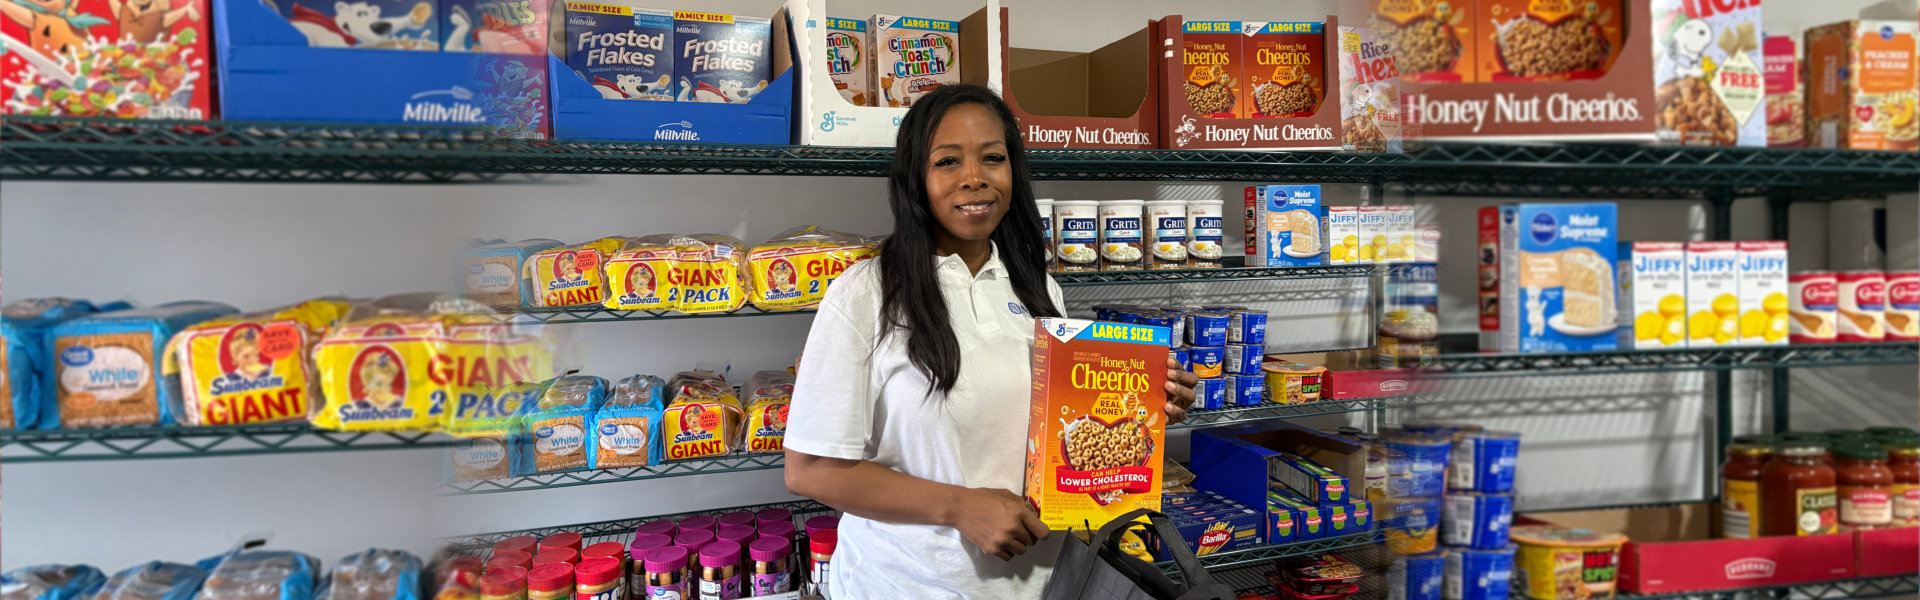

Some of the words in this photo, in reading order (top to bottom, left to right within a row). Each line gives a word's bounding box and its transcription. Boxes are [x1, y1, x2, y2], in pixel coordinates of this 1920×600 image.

[568, 3, 600, 11] FAMILY
[603, 5, 621, 13] SIZE
[675, 12, 704, 20] FAMILY
[570, 18, 597, 26] Millville
[838, 20, 857, 29] SIZE
[902, 19, 929, 29] LARGE
[932, 21, 950, 30] SIZE
[1187, 23, 1212, 31] LARGE
[1213, 23, 1230, 31] SIZE
[676, 26, 701, 34] Millville
[1269, 24, 1294, 32] LARGE
[1296, 24, 1311, 32] SIZE
[578, 30, 664, 51] Frosted
[891, 36, 943, 50] Cinnamon
[683, 37, 763, 58] Frosted
[1194, 43, 1211, 51] Honey
[1276, 43, 1294, 51] Honey
[1361, 42, 1389, 59] Rice
[587, 47, 656, 67] Flakes
[901, 47, 936, 62] Toast
[1257, 48, 1310, 65] Cheerios
[692, 54, 754, 73] Flakes
[896, 58, 945, 77] Crunch
[1874, 61, 1909, 69] CREAM
[1720, 72, 1759, 88] FREE
[403, 102, 482, 122] Millville
[1377, 113, 1399, 122] FREE
[1407, 93, 1488, 133] Honey
[1495, 93, 1540, 123] Nut
[1546, 92, 1639, 122] Cheerios
[655, 130, 698, 141] Millville
[1029, 125, 1072, 147] Honey
[1075, 127, 1099, 143] Nut
[1103, 128, 1149, 145] Cheerios
[1205, 125, 1250, 146] Honey
[1253, 124, 1279, 141] Nut
[1282, 124, 1332, 141] Cheerios
[1289, 197, 1316, 206] Supreme
[1164, 219, 1185, 228] GRITS
[1201, 218, 1222, 228] GRITS
[1331, 214, 1356, 223] JIFFY
[1360, 214, 1385, 223] JIFFY
[1389, 214, 1412, 222] JIFFY
[1569, 213, 1599, 226] Moist
[1068, 220, 1094, 230] GRITS
[1111, 219, 1138, 229] GRITS
[1560, 226, 1608, 241] Supreme
[1636, 256, 1681, 272] JIFFY
[1689, 256, 1735, 272] JIFFY
[1741, 255, 1785, 272] JIFFY
[482, 274, 509, 283] White
[549, 279, 588, 290] Sunbeam
[809, 280, 819, 293] 2
[547, 286, 599, 307] GIANT
[619, 295, 660, 306] Sunbeam
[668, 287, 678, 301] 2
[683, 287, 730, 303] PACK
[765, 290, 801, 300] Sunbeam
[263, 329, 291, 339] SAVE
[1092, 324, 1127, 339] LARGE
[1130, 328, 1153, 341] SIZE
[263, 342, 294, 353] CARD
[1101, 357, 1127, 371] Honey
[1130, 359, 1145, 369] Nut
[89, 367, 139, 383] White
[1072, 363, 1149, 392] Cheerios
[1303, 376, 1318, 385] HOT
[210, 377, 283, 395] Sunbeam
[207, 387, 301, 425] GIANT
[429, 390, 446, 416] 2
[339, 406, 413, 422] Sunbeam
[551, 436, 579, 446] White
[614, 437, 640, 445] White
[674, 433, 713, 443] Sunbeam
[671, 440, 721, 458] GIANT
[471, 451, 499, 460] White
[1061, 477, 1091, 486] LOWER
[1092, 474, 1148, 485] CHOLESTEROL
[1202, 533, 1227, 544] Barilla
[1585, 553, 1613, 568] HOT
